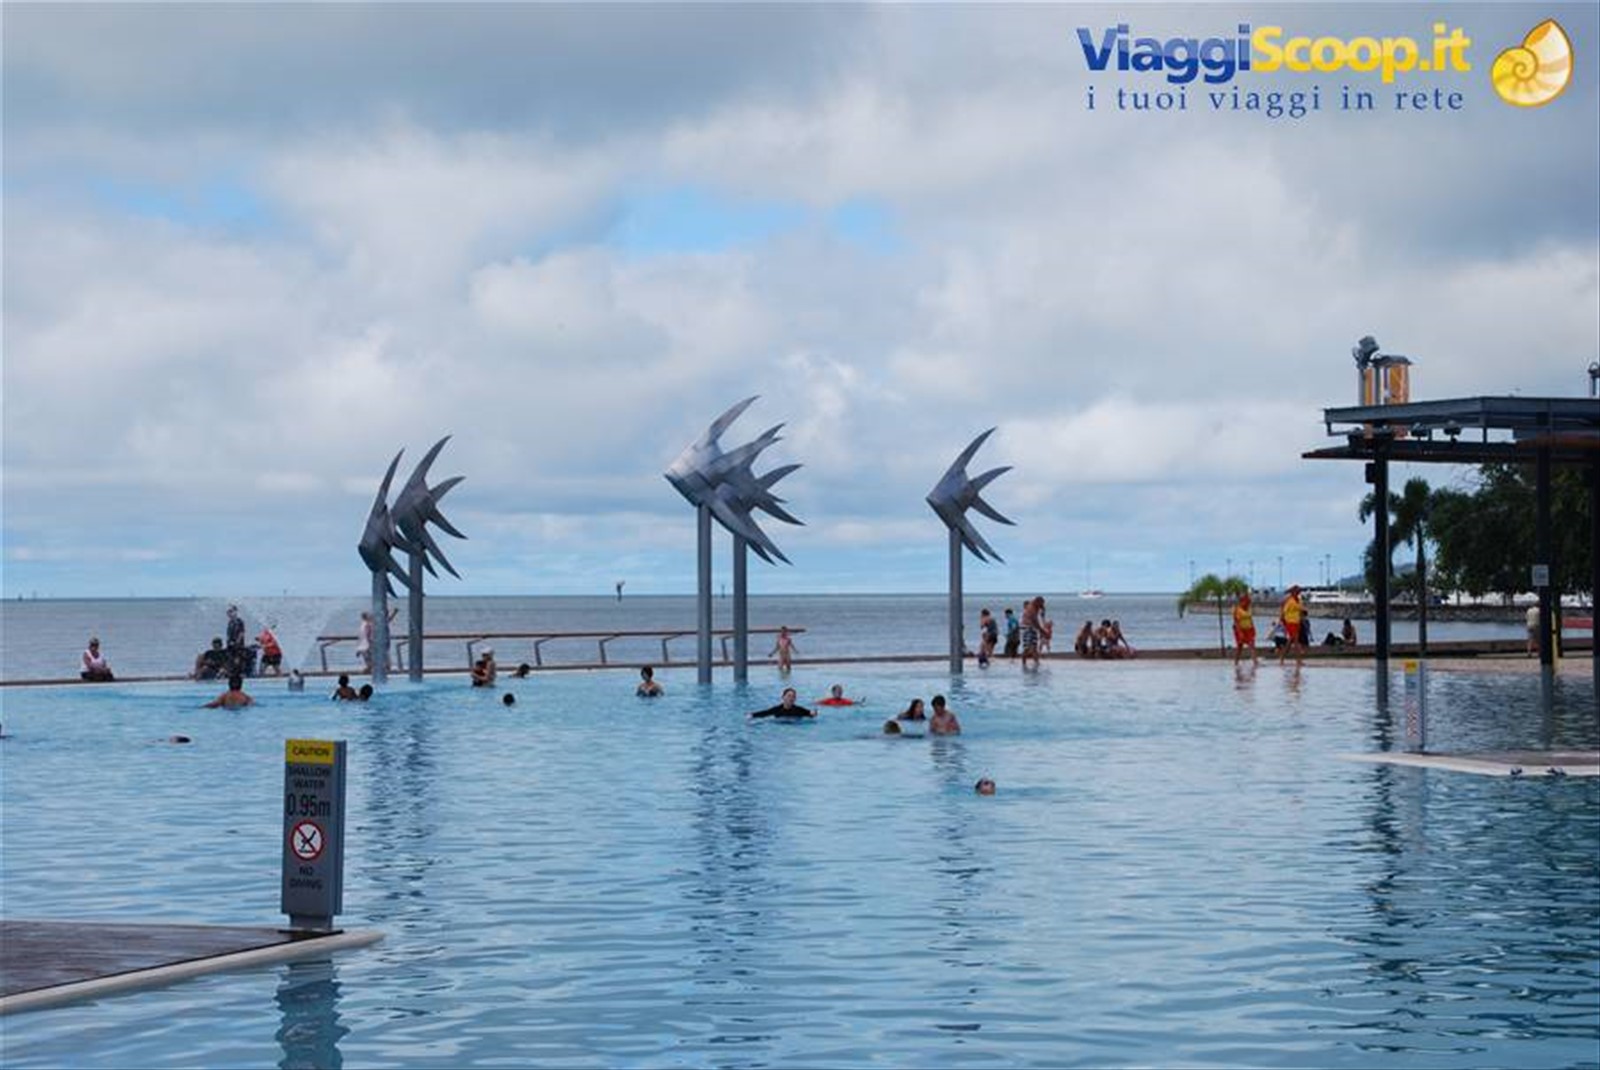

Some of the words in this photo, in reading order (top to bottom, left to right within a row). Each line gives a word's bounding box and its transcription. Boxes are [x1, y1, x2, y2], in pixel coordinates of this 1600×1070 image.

[292, 746, 330, 756] CAUTION
[294, 779, 325, 790] WATER
[287, 794, 331, 817] 0.95m
[299, 866, 315, 875] NO
